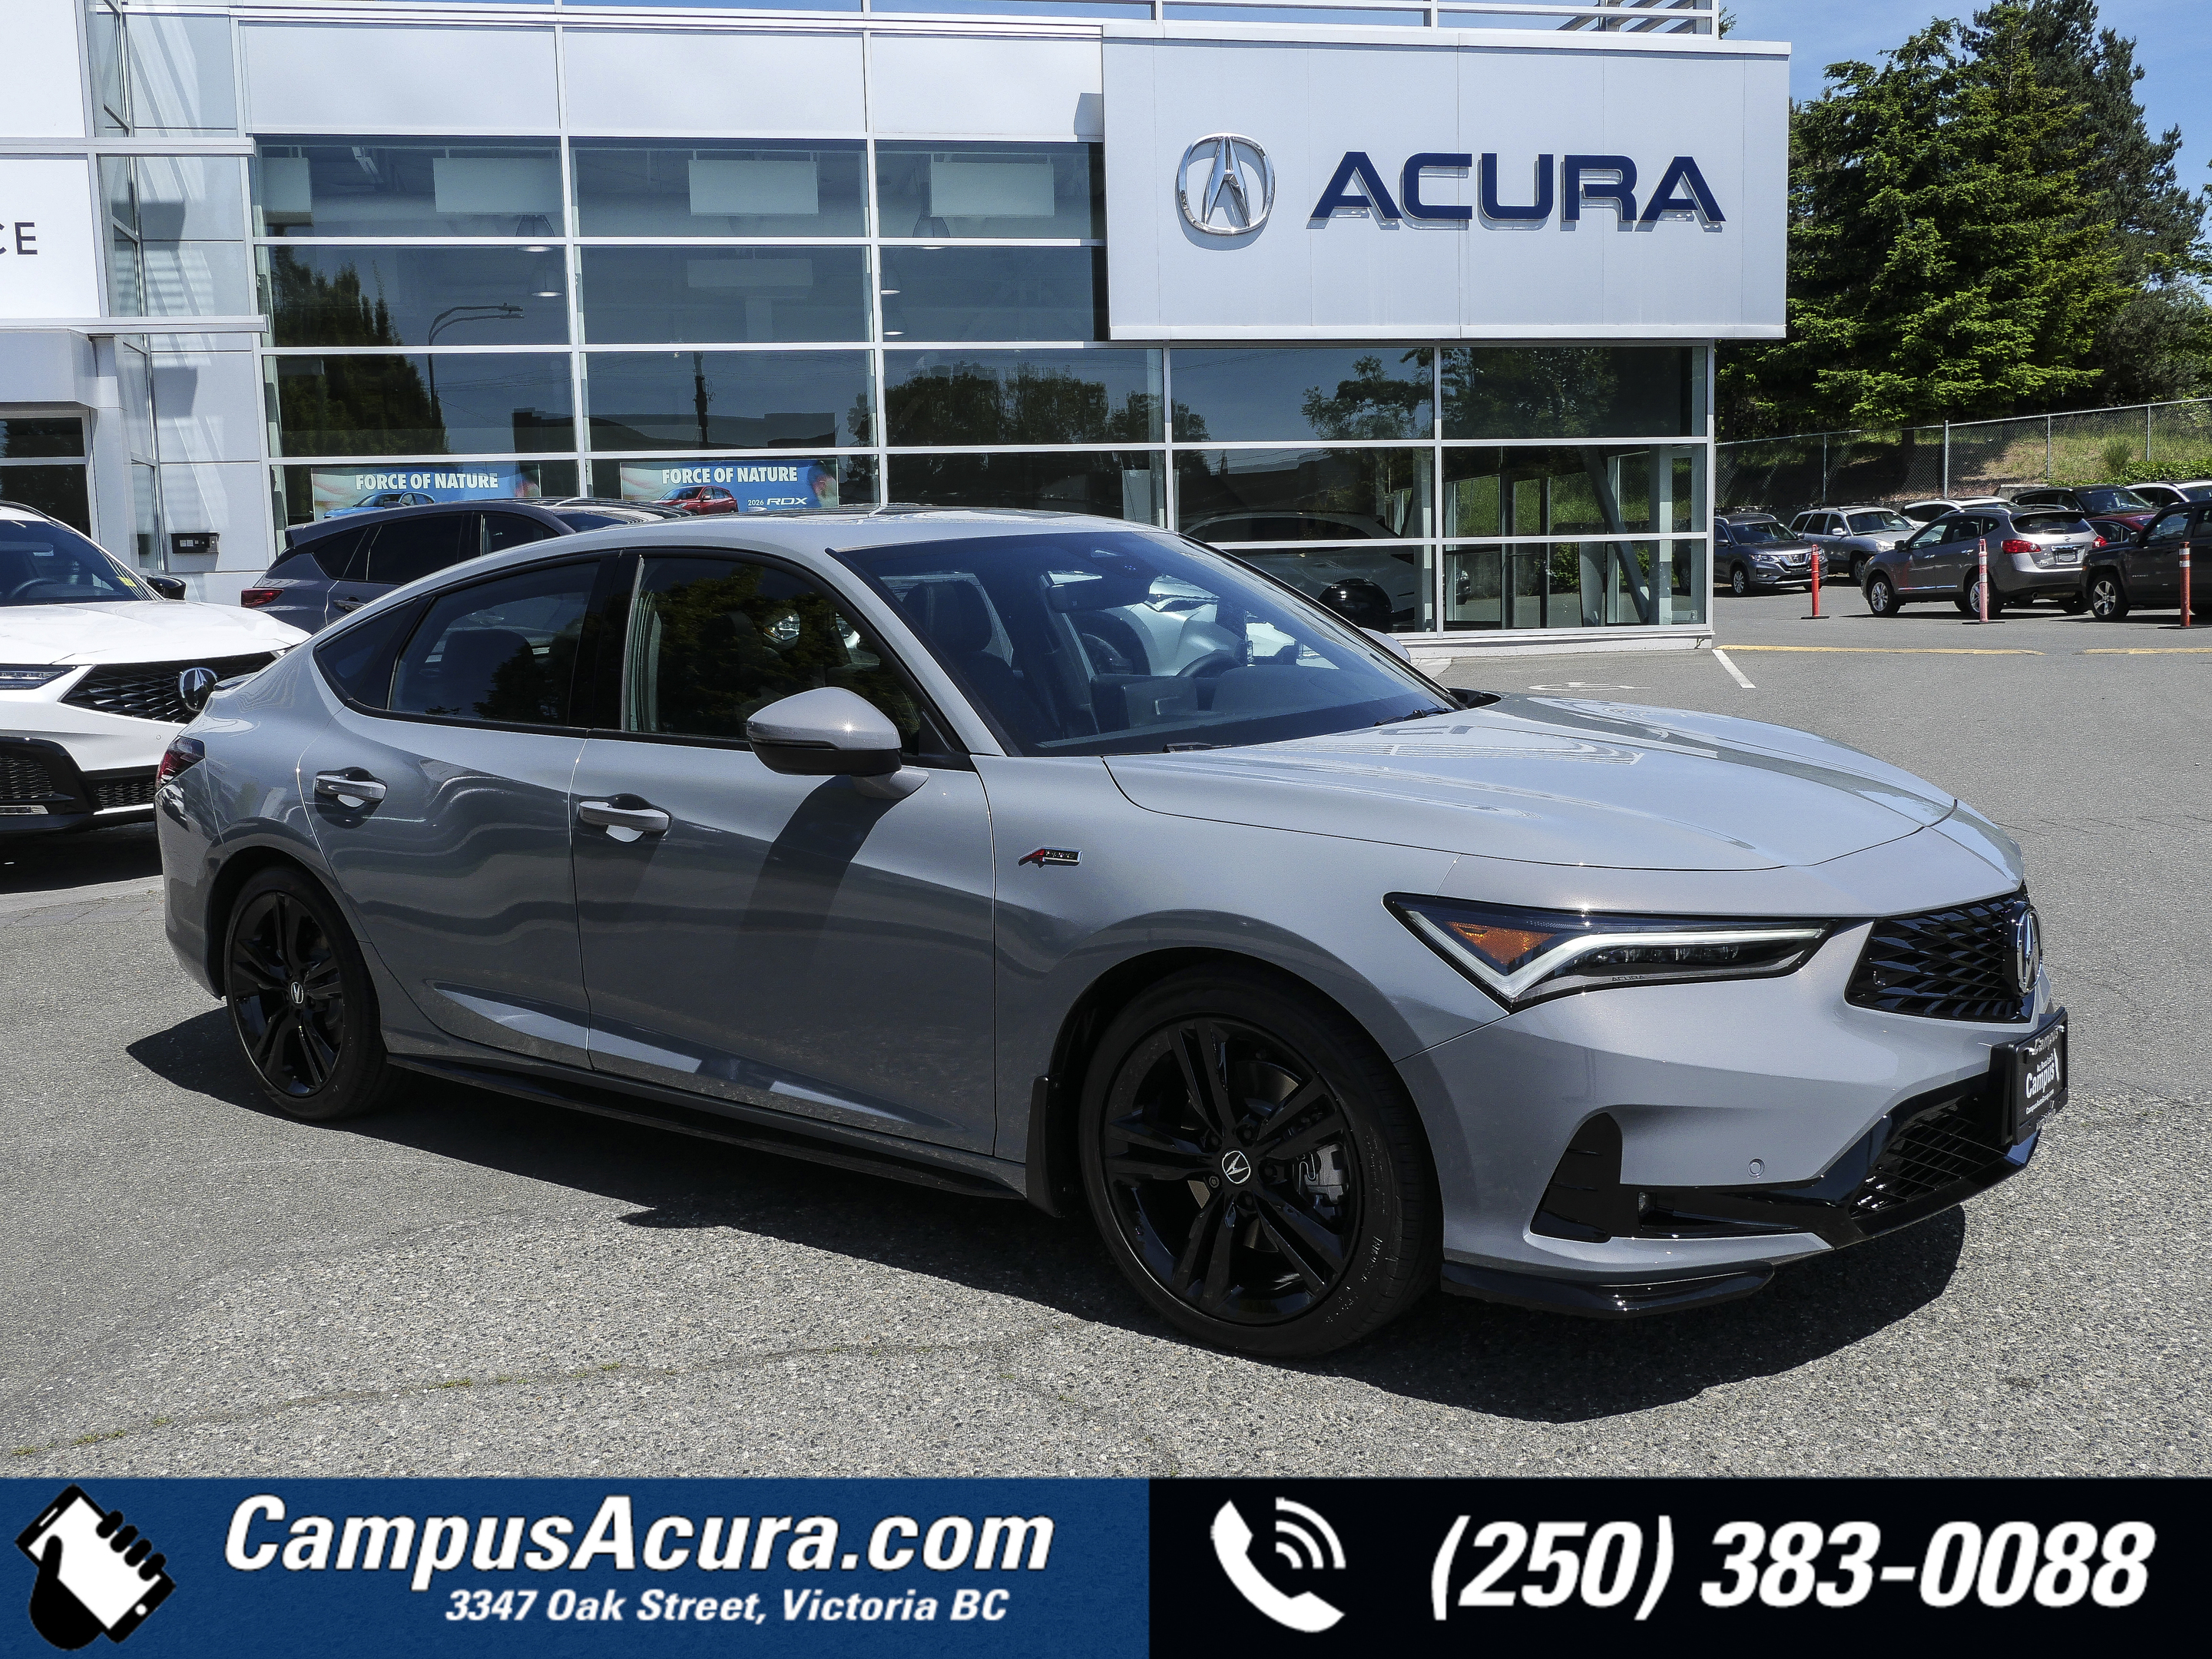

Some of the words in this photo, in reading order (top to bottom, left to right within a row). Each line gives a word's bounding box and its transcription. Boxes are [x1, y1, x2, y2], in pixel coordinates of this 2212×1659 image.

[1310, 151, 1727, 222] ACURA
[0, 222, 38, 255] E
[356, 474, 407, 490] FORCE
[409, 473, 431, 488] OF
[434, 473, 498, 488] NATURE
[662, 469, 710, 484] FORCE
[714, 468, 733, 483] OF
[737, 466, 798, 482] NATURE
[767, 497, 808, 505] RDX
[2025, 1061, 2055, 1099] Campus
